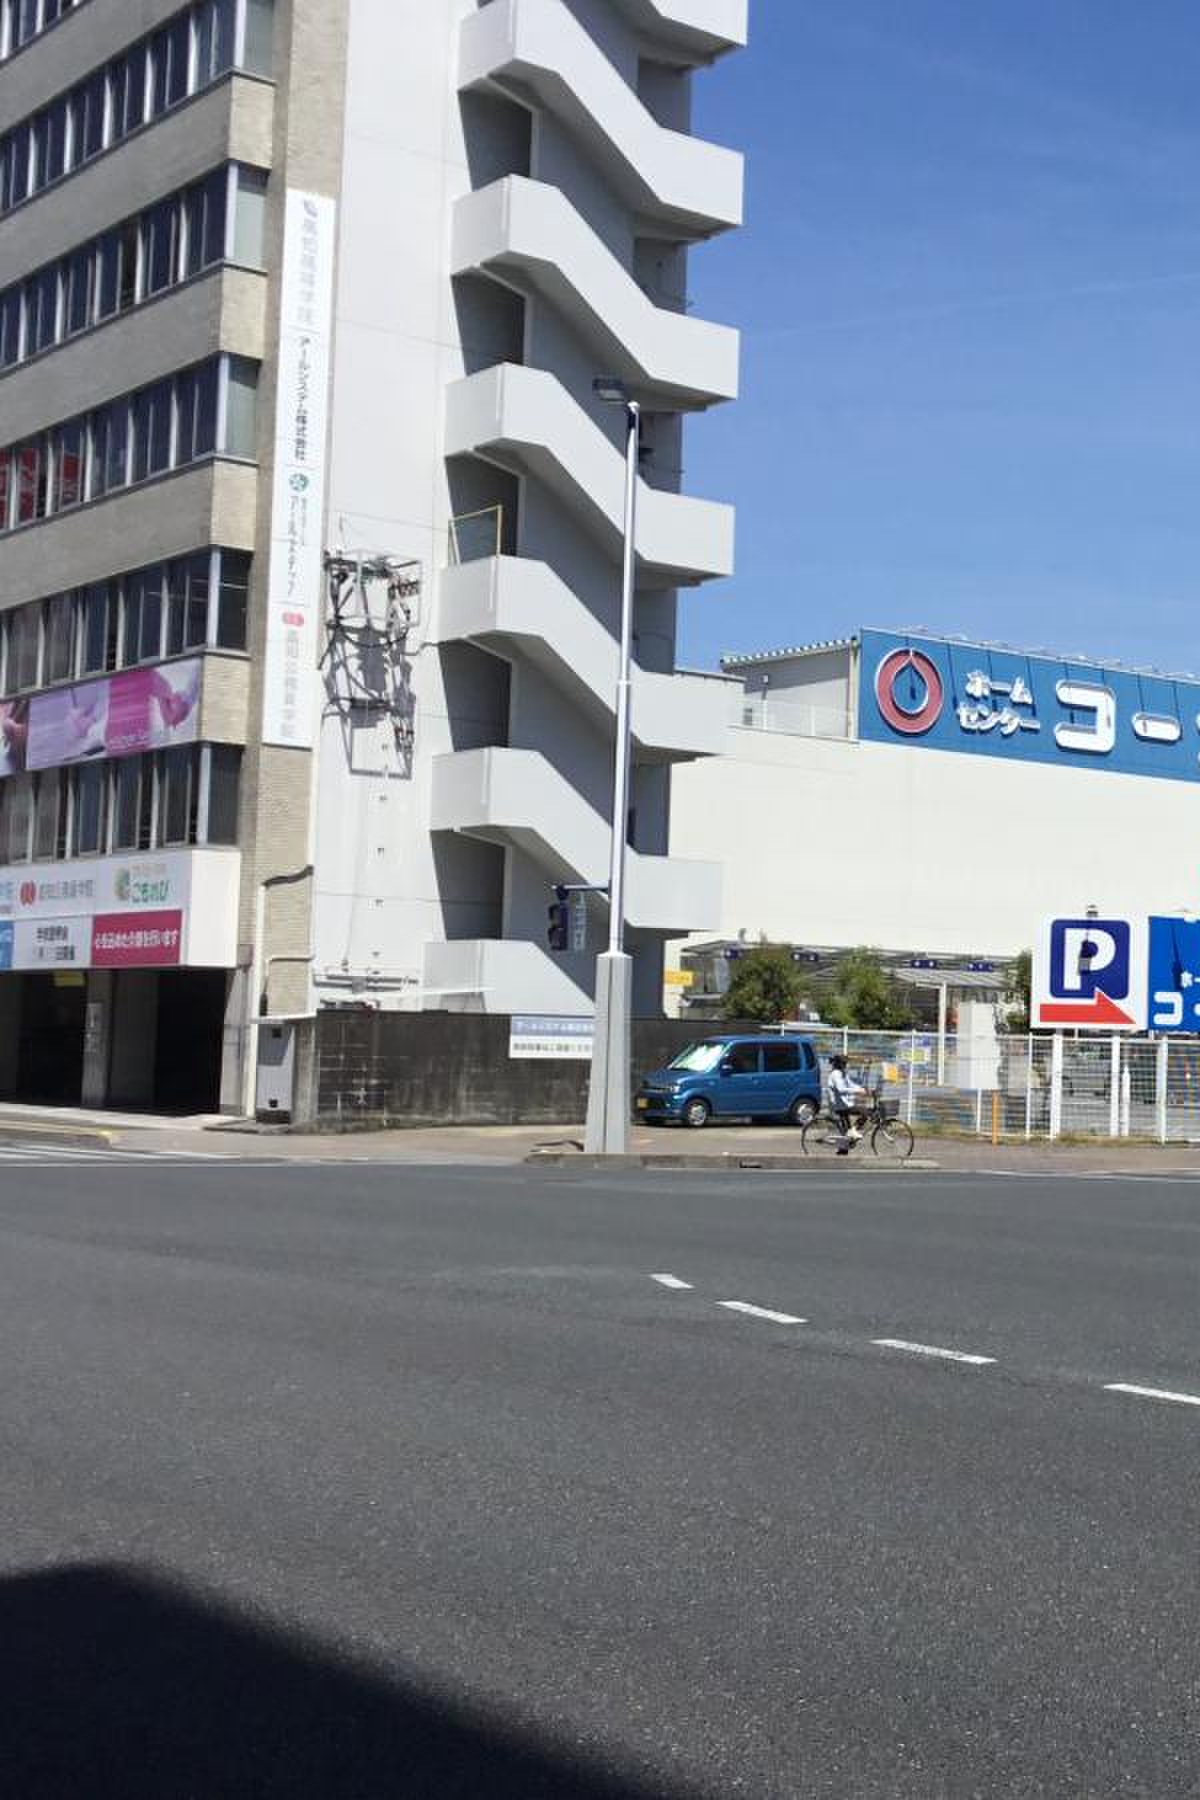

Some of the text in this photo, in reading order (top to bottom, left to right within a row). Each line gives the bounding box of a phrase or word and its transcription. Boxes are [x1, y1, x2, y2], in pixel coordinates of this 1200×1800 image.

[965, 670, 1033, 704] ホーム
[957, 701, 1041, 735] センター
[1063, 928, 1117, 990] P
